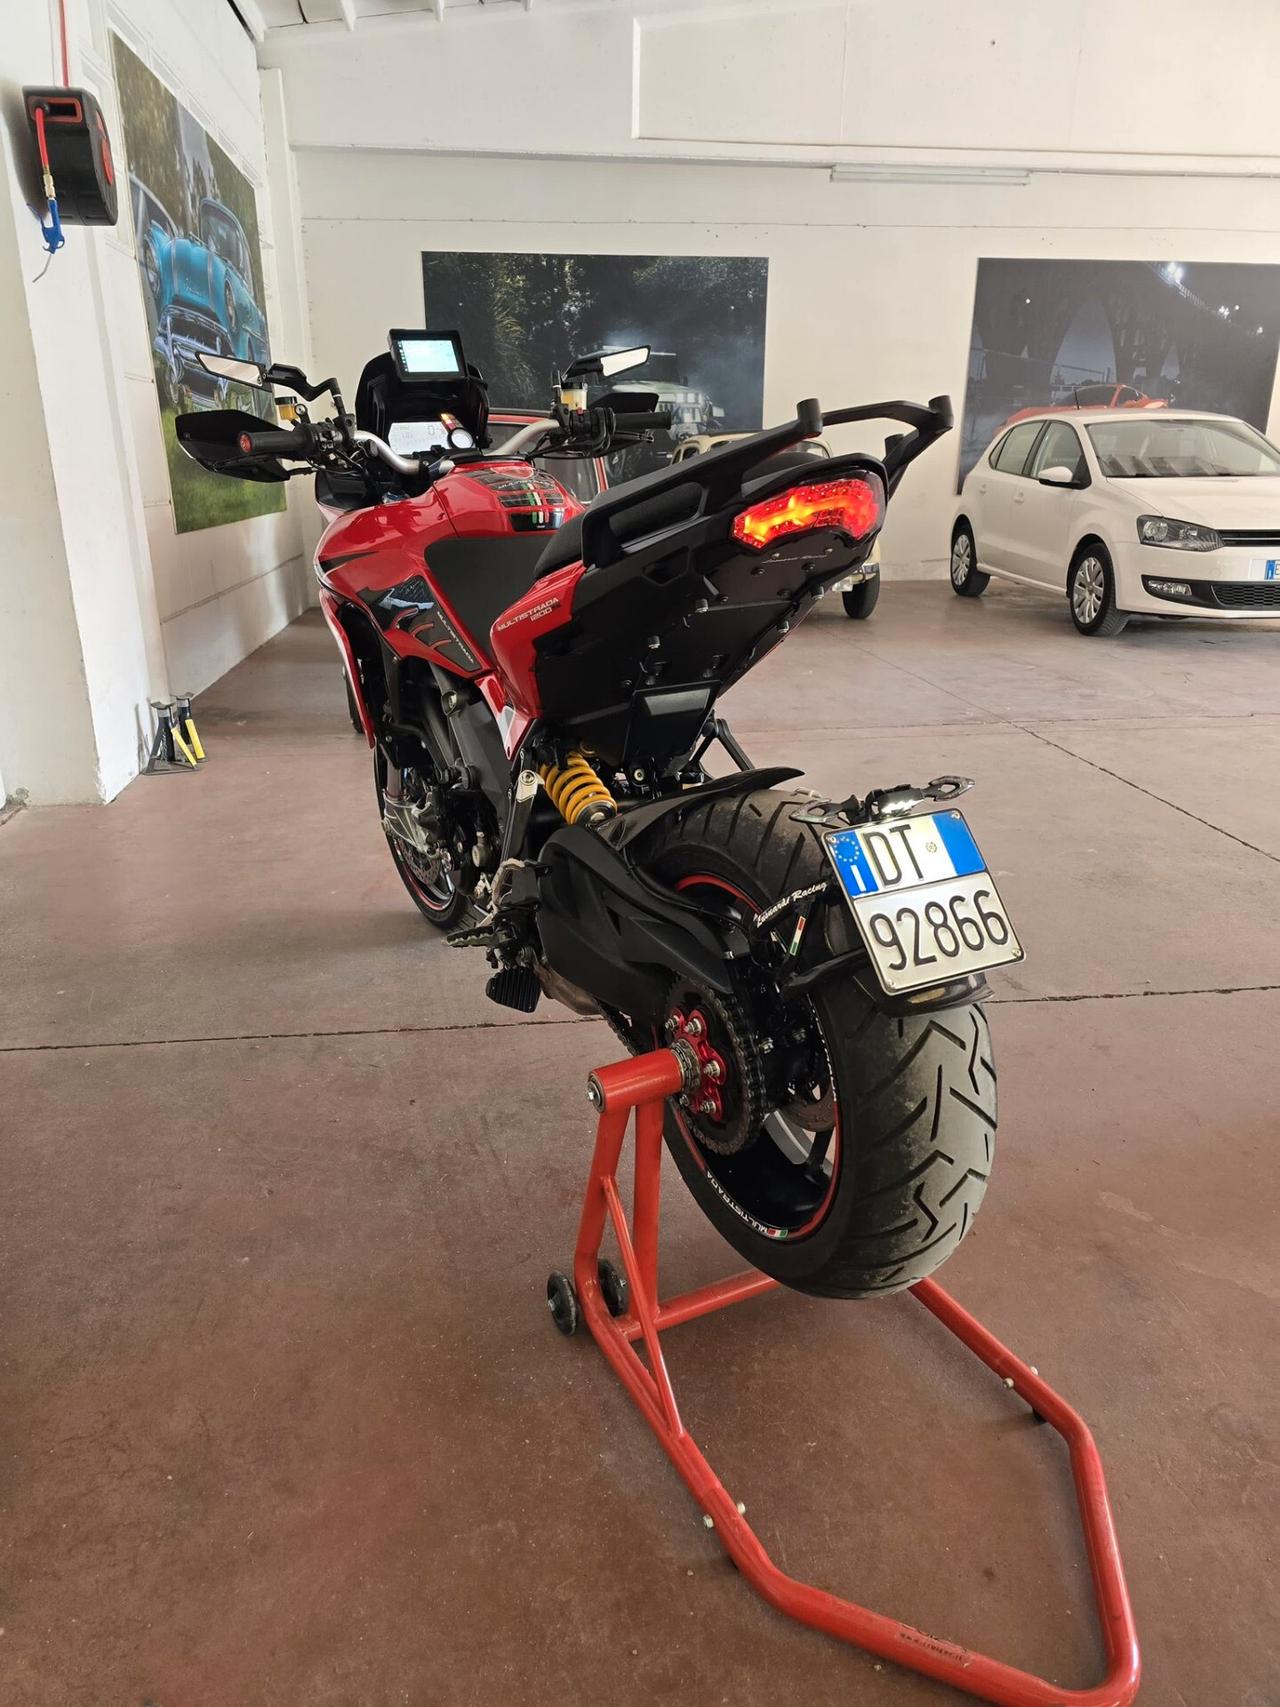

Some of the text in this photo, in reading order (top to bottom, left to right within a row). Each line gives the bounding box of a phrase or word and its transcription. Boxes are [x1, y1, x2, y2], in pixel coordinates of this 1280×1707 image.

[497, 597, 559, 632] MULTISTRADA
[863, 823, 925, 887] DT
[791, 881, 828, 902] Racing
[869, 889, 1009, 971] 92866
[706, 1170, 768, 1233] MULTISTRADA
